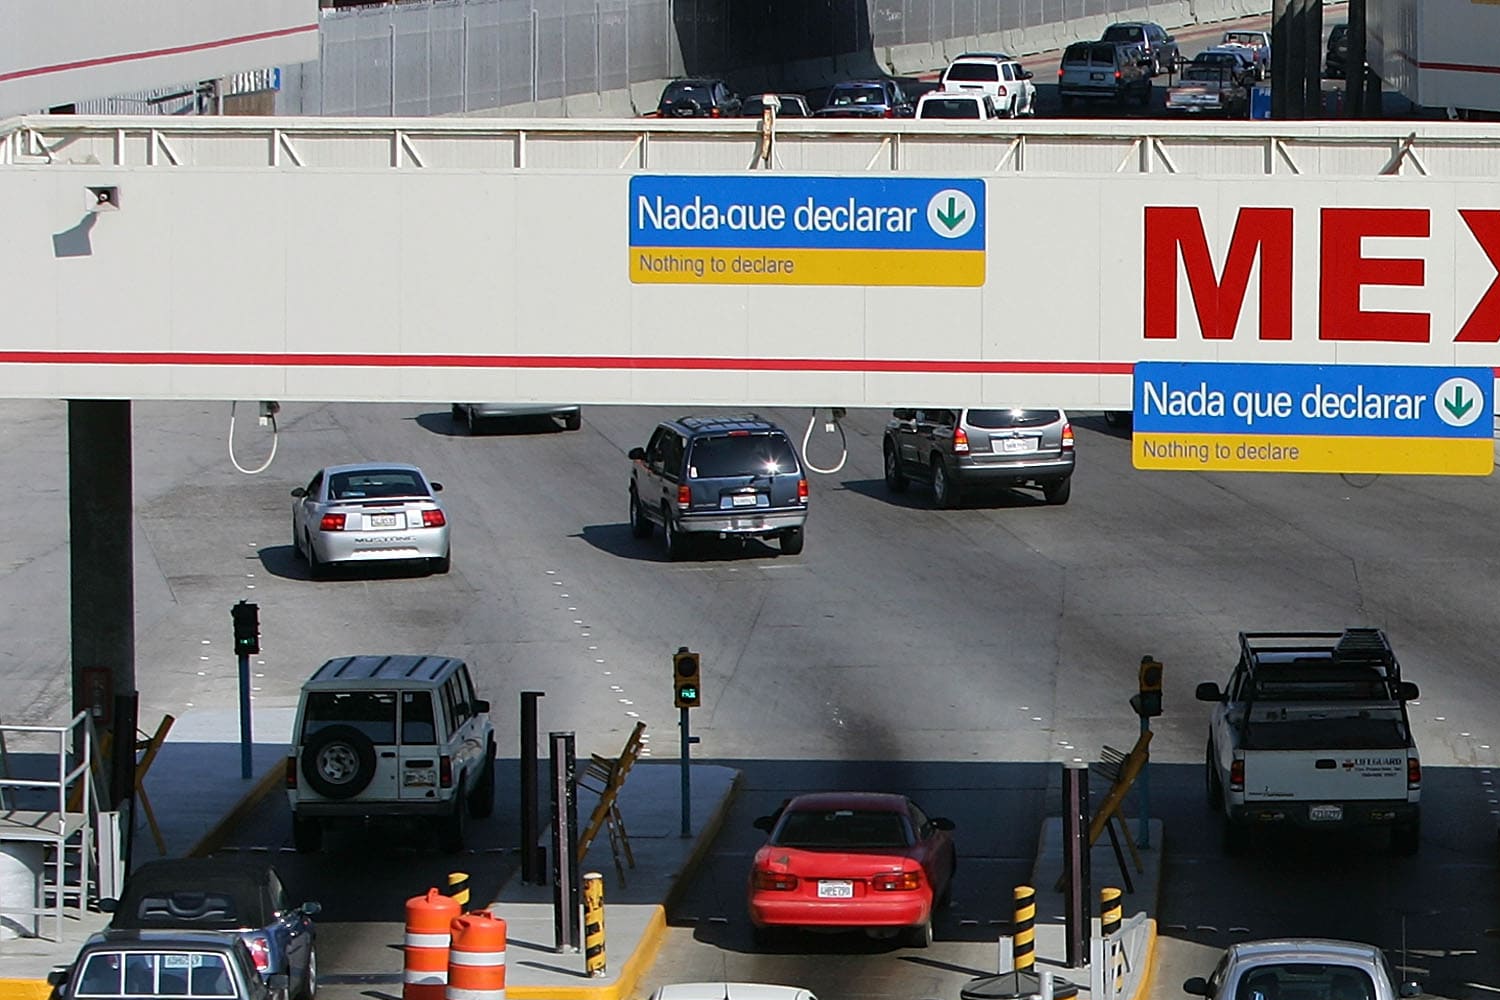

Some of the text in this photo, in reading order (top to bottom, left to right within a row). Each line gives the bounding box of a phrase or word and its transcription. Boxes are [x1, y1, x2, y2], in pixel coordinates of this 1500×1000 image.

[638, 196, 720, 229] Nada
[794, 197, 918, 232] declarar
[639, 255, 794, 277] Nothing to declare
[1143, 381, 1427, 425] Nada que declarar
[1142, 441, 1300, 464] Nothing to declare
